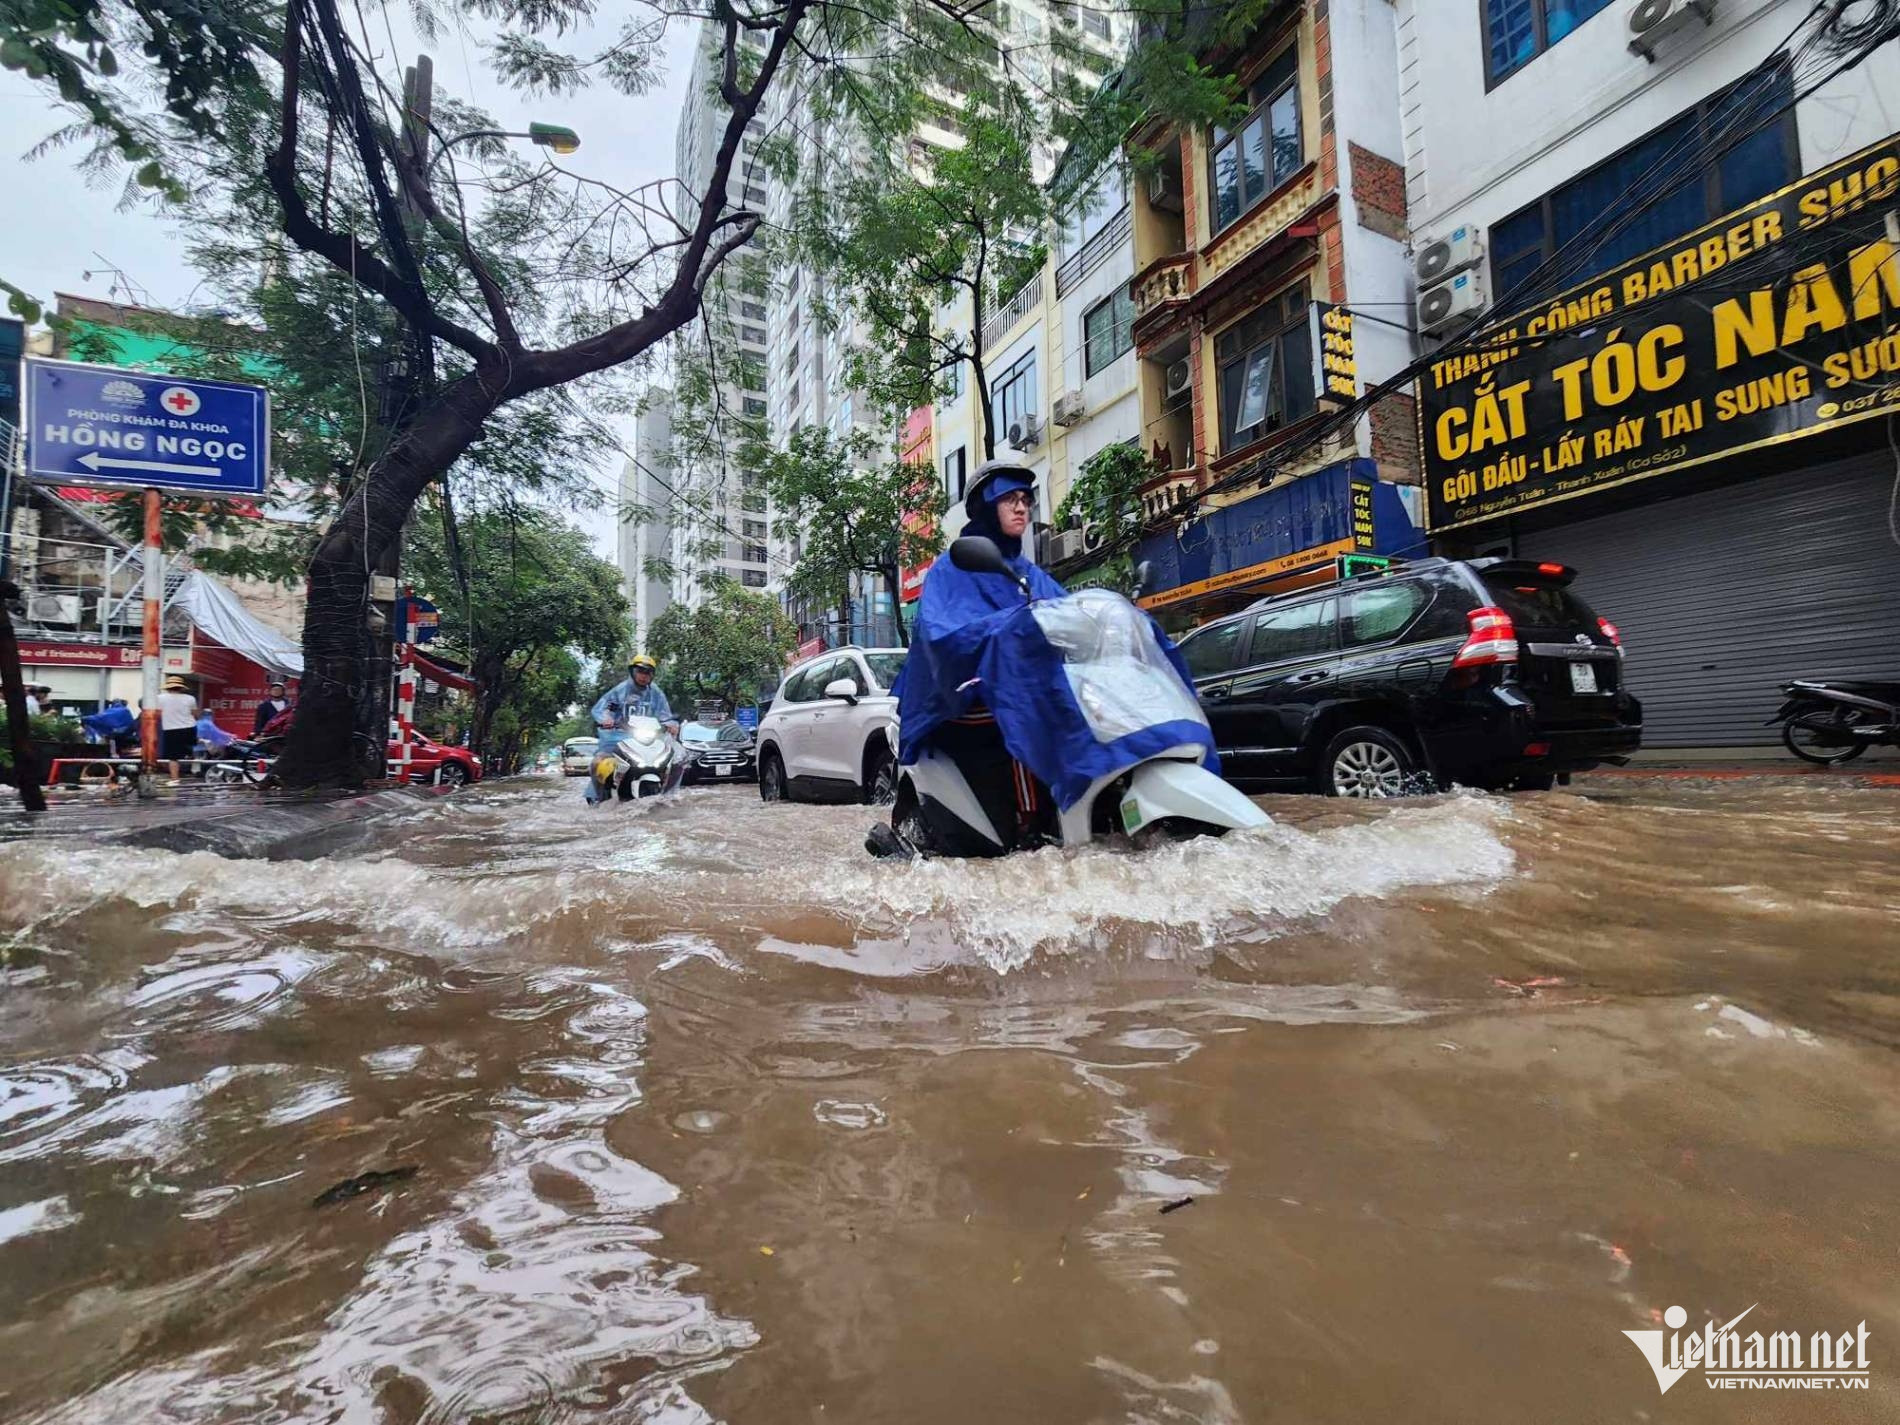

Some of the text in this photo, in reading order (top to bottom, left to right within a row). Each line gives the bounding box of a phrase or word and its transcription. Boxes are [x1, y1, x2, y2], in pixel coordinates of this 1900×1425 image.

[1527, 287, 1613, 348] CÔNG
[1623, 210, 1783, 306] BARBER
[1799, 156, 1900, 231] SHO
[45, 422, 247, 462] HỒNG NGỌC
[68, 408, 230, 435] PHÒNG KHÁM ĐA KHOA
[1435, 370, 1530, 461] CẮT
[1552, 324, 1685, 422] TÓC
[1443, 469, 1477, 505] GỘI
[1482, 452, 1527, 492] ĐẦU
[1543, 430, 1586, 474] LẤY
[1593, 416, 1643, 459] RÁY
[1656, 399, 1703, 438] TAI
[1714, 365, 1811, 422] SUNG
[1823, 323, 1900, 389] SƯỚ
